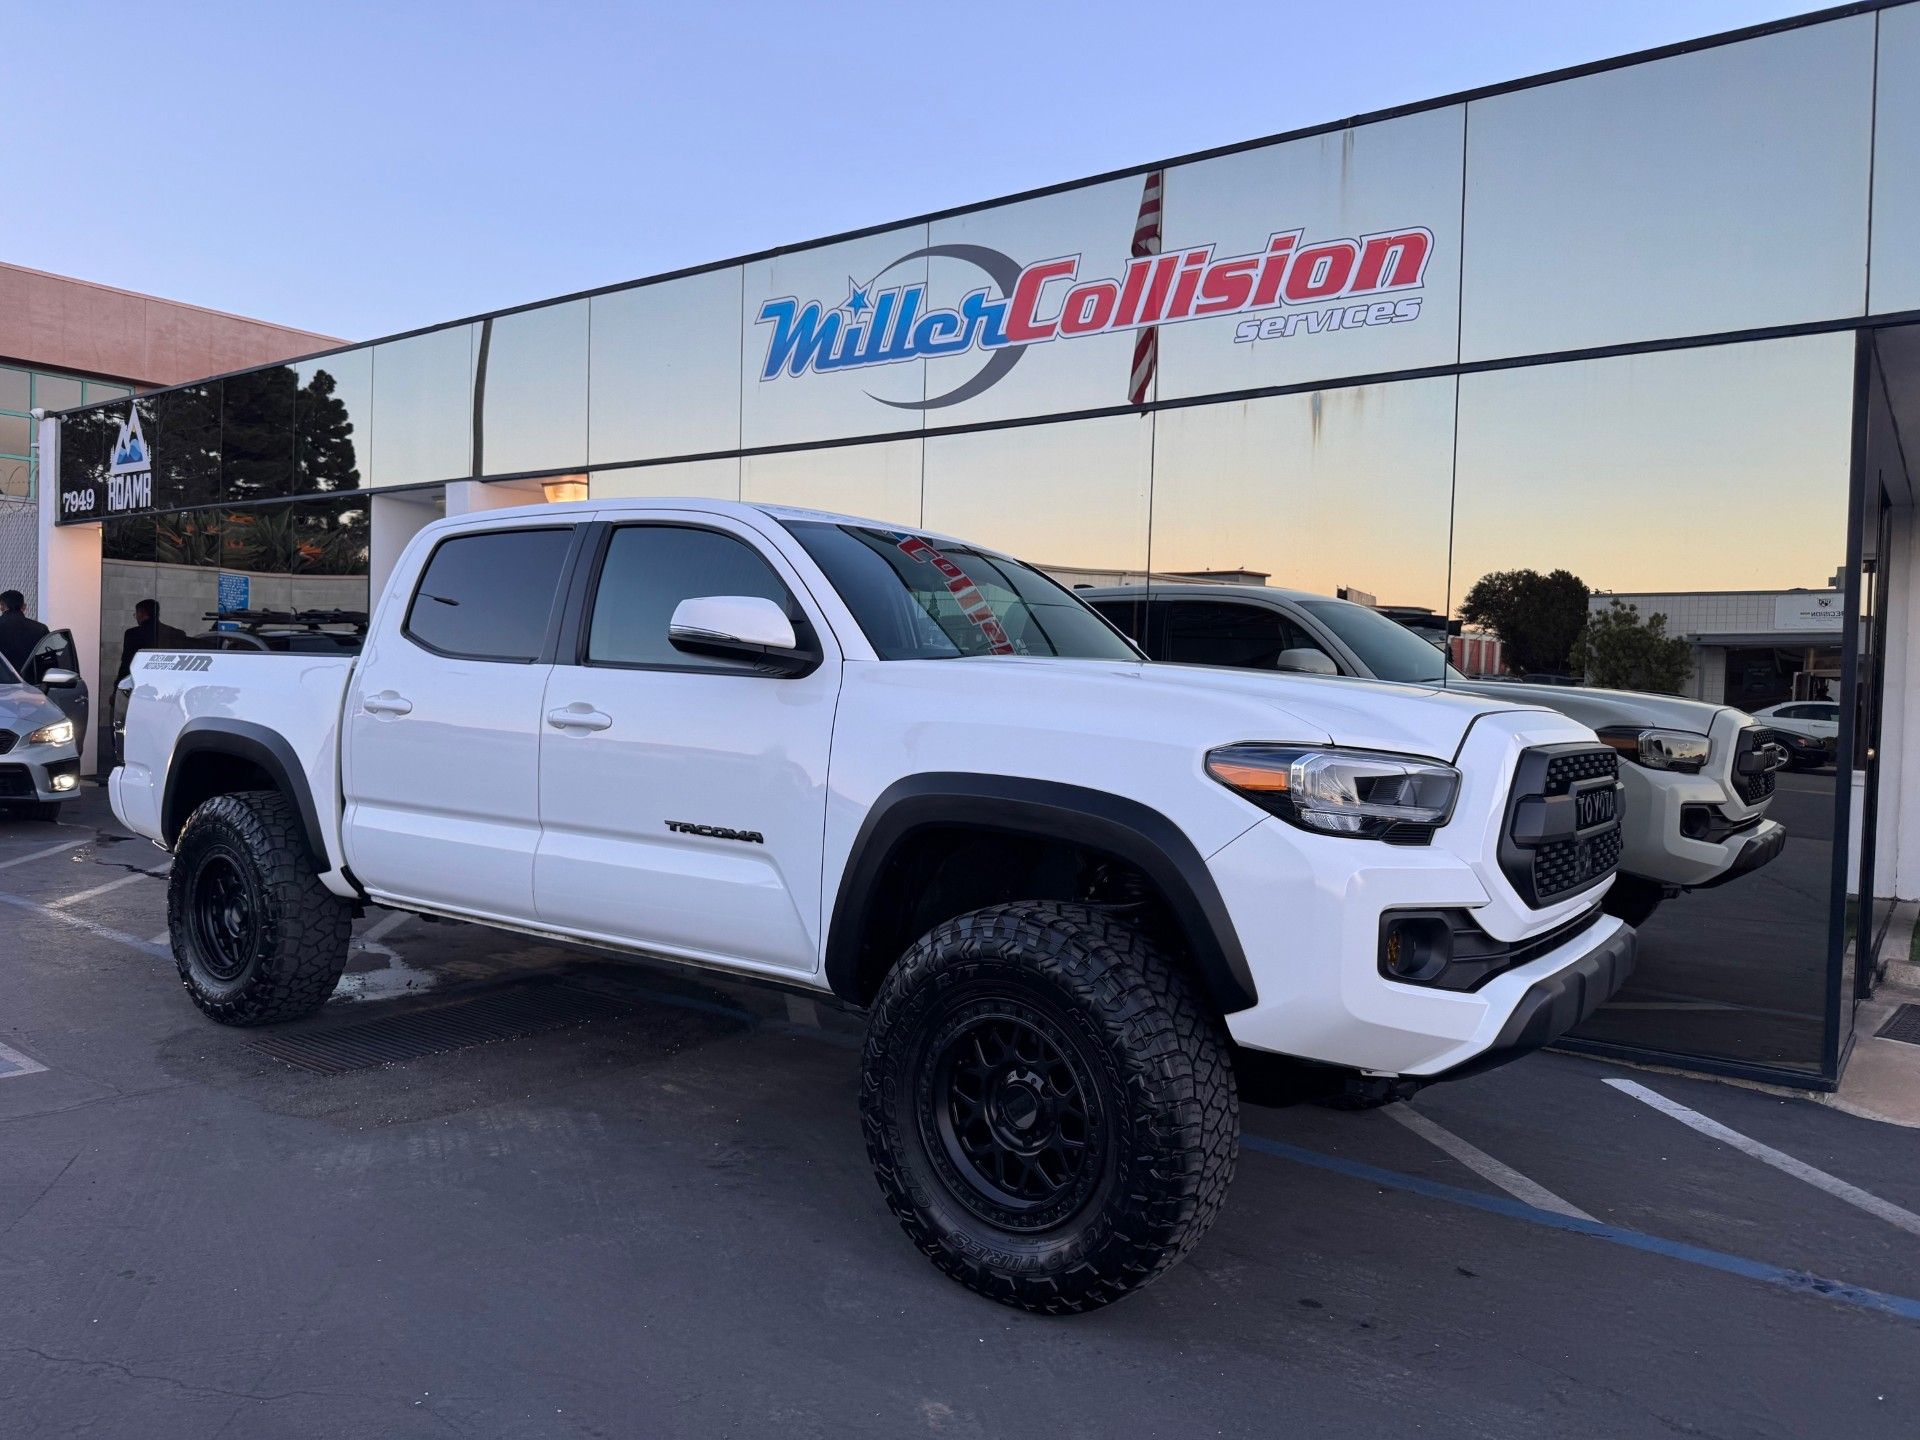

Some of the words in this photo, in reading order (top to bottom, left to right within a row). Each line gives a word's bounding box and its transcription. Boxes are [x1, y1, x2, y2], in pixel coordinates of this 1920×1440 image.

[756, 277, 1009, 381] Miller
[1001, 227, 1434, 345] Collision
[1234, 298, 1422, 343] services
[63, 488, 95, 513] 7949
[108, 472, 151, 511] ROAMR
[1577, 790, 1614, 825] TOYOTA
[664, 820, 764, 844] TACOMA
[950, 1231, 1038, 1271] TIRES
